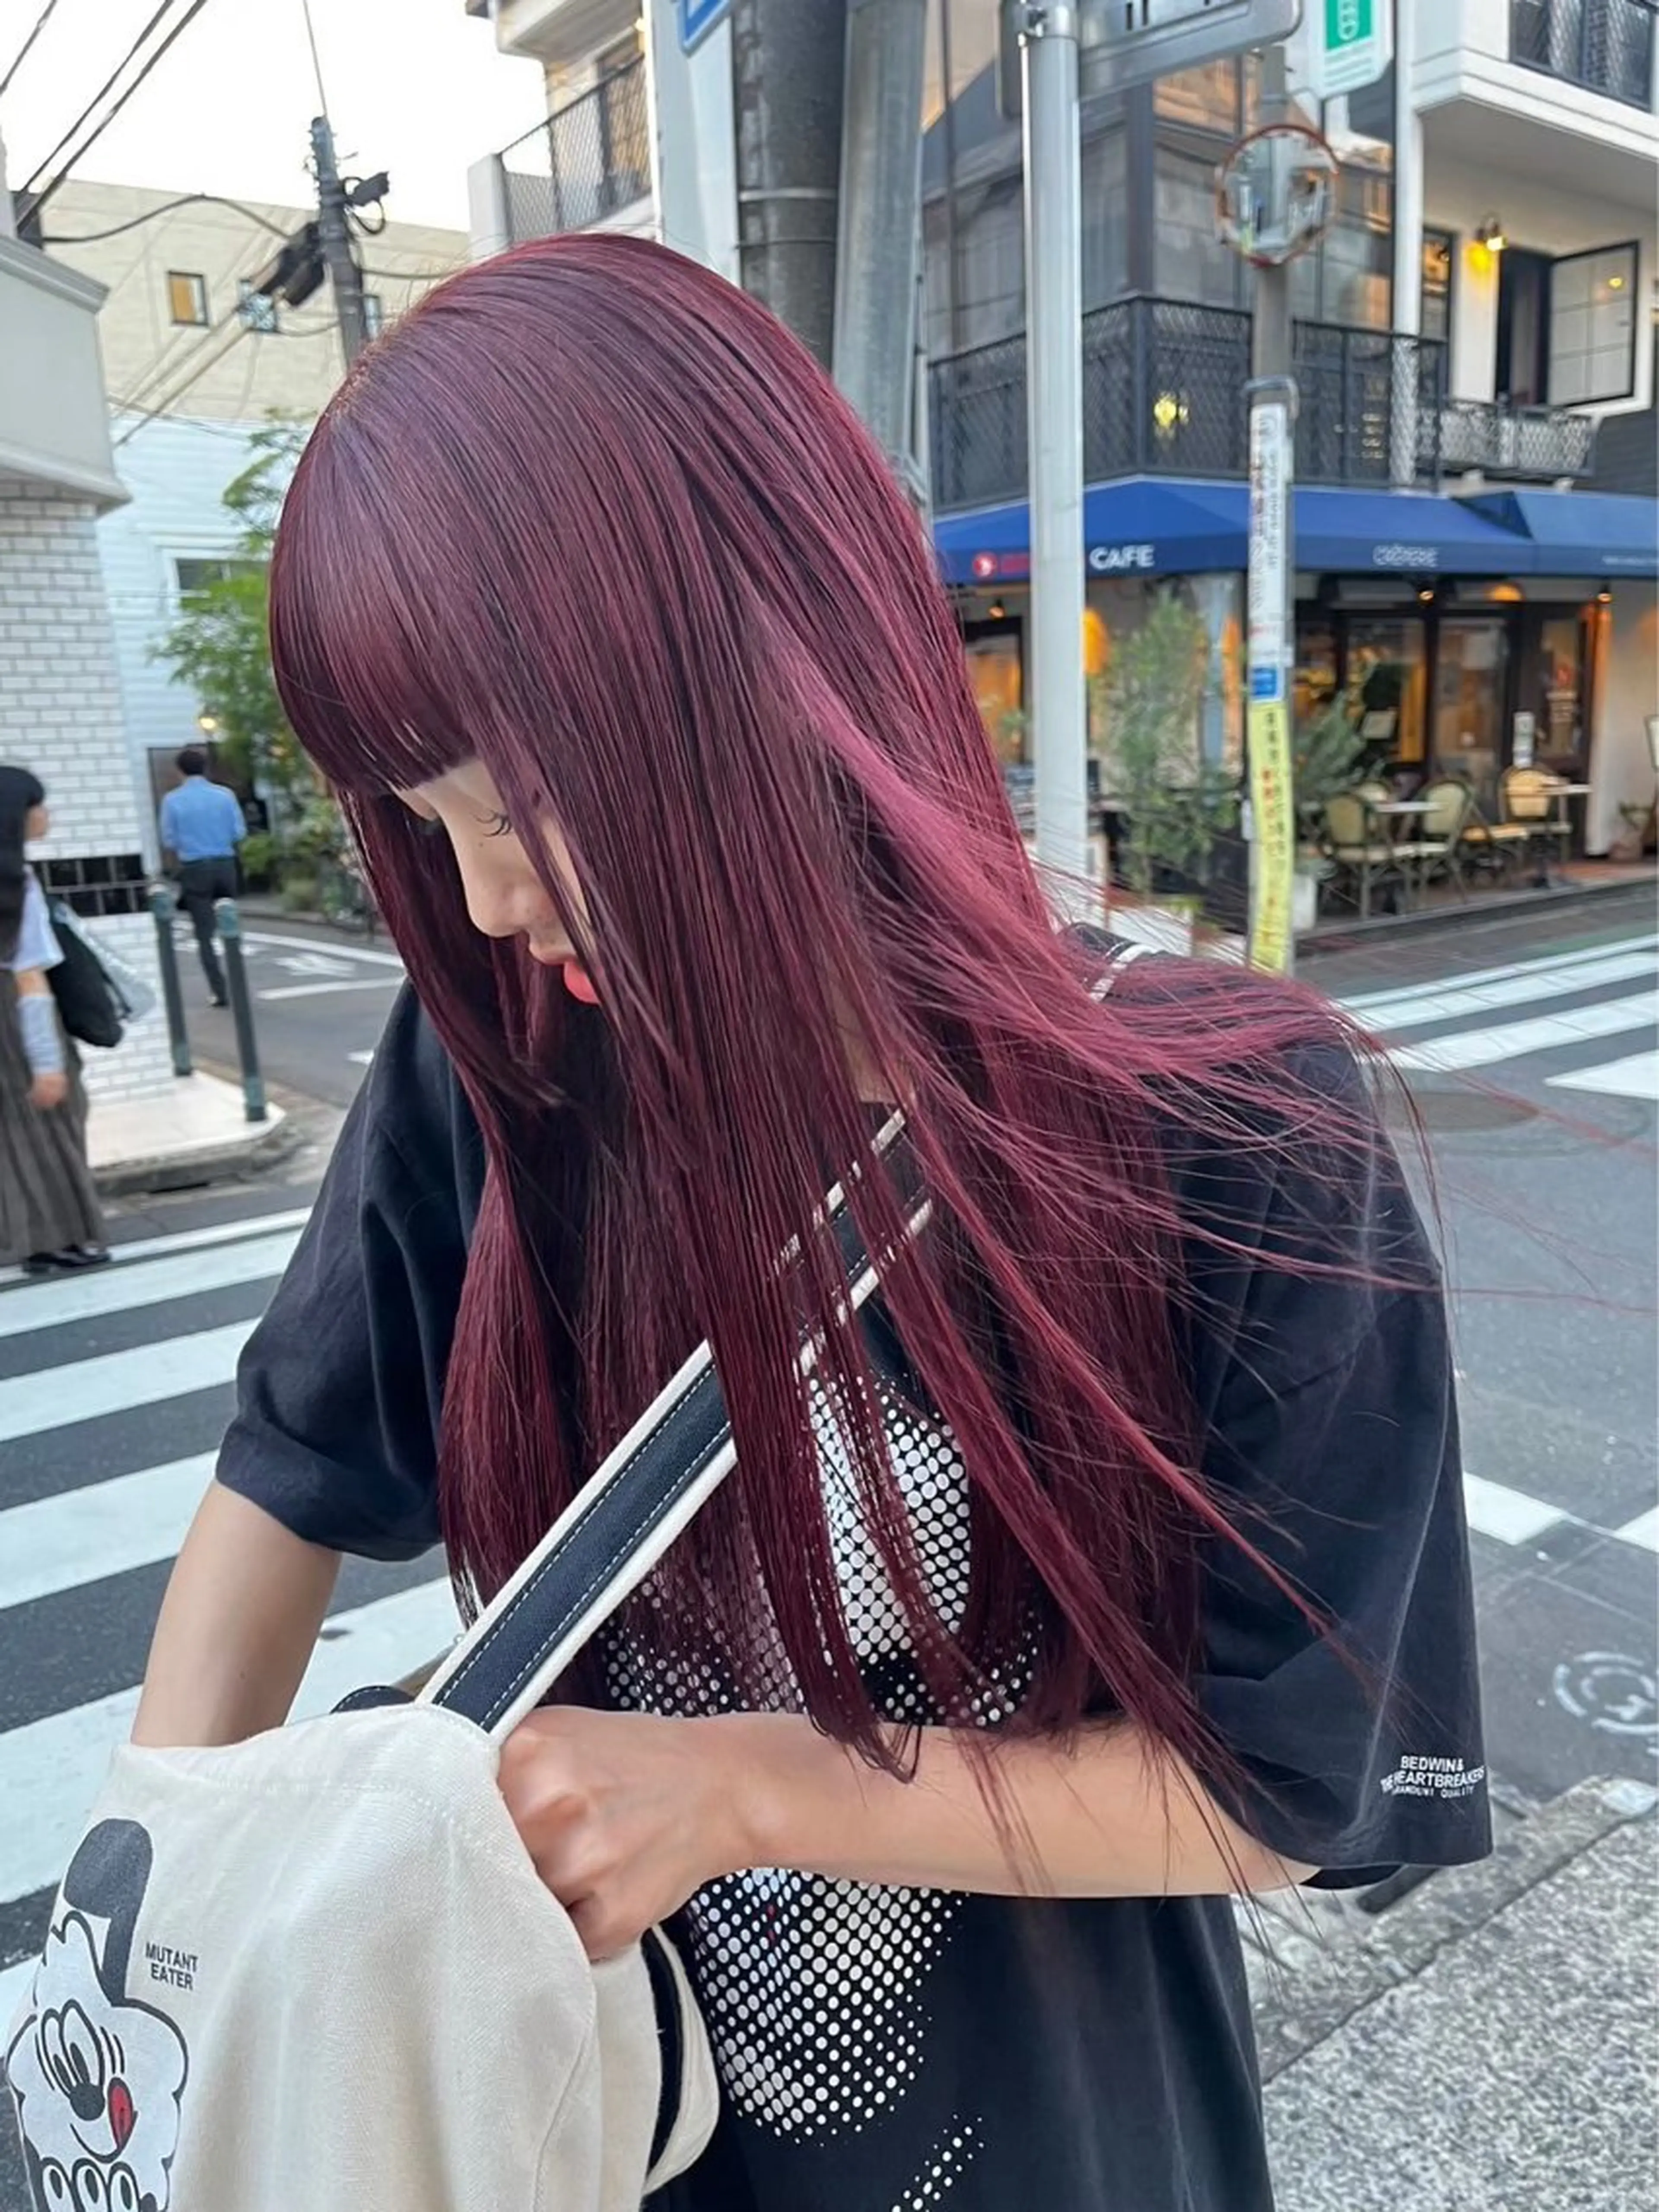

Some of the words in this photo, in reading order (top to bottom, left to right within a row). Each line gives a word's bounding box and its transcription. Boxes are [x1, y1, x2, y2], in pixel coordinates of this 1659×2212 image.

[1089, 545, 1154, 570] CAFE
[146, 1941, 198, 1972] MUTANT
[151, 1963, 193, 1990] EATER
